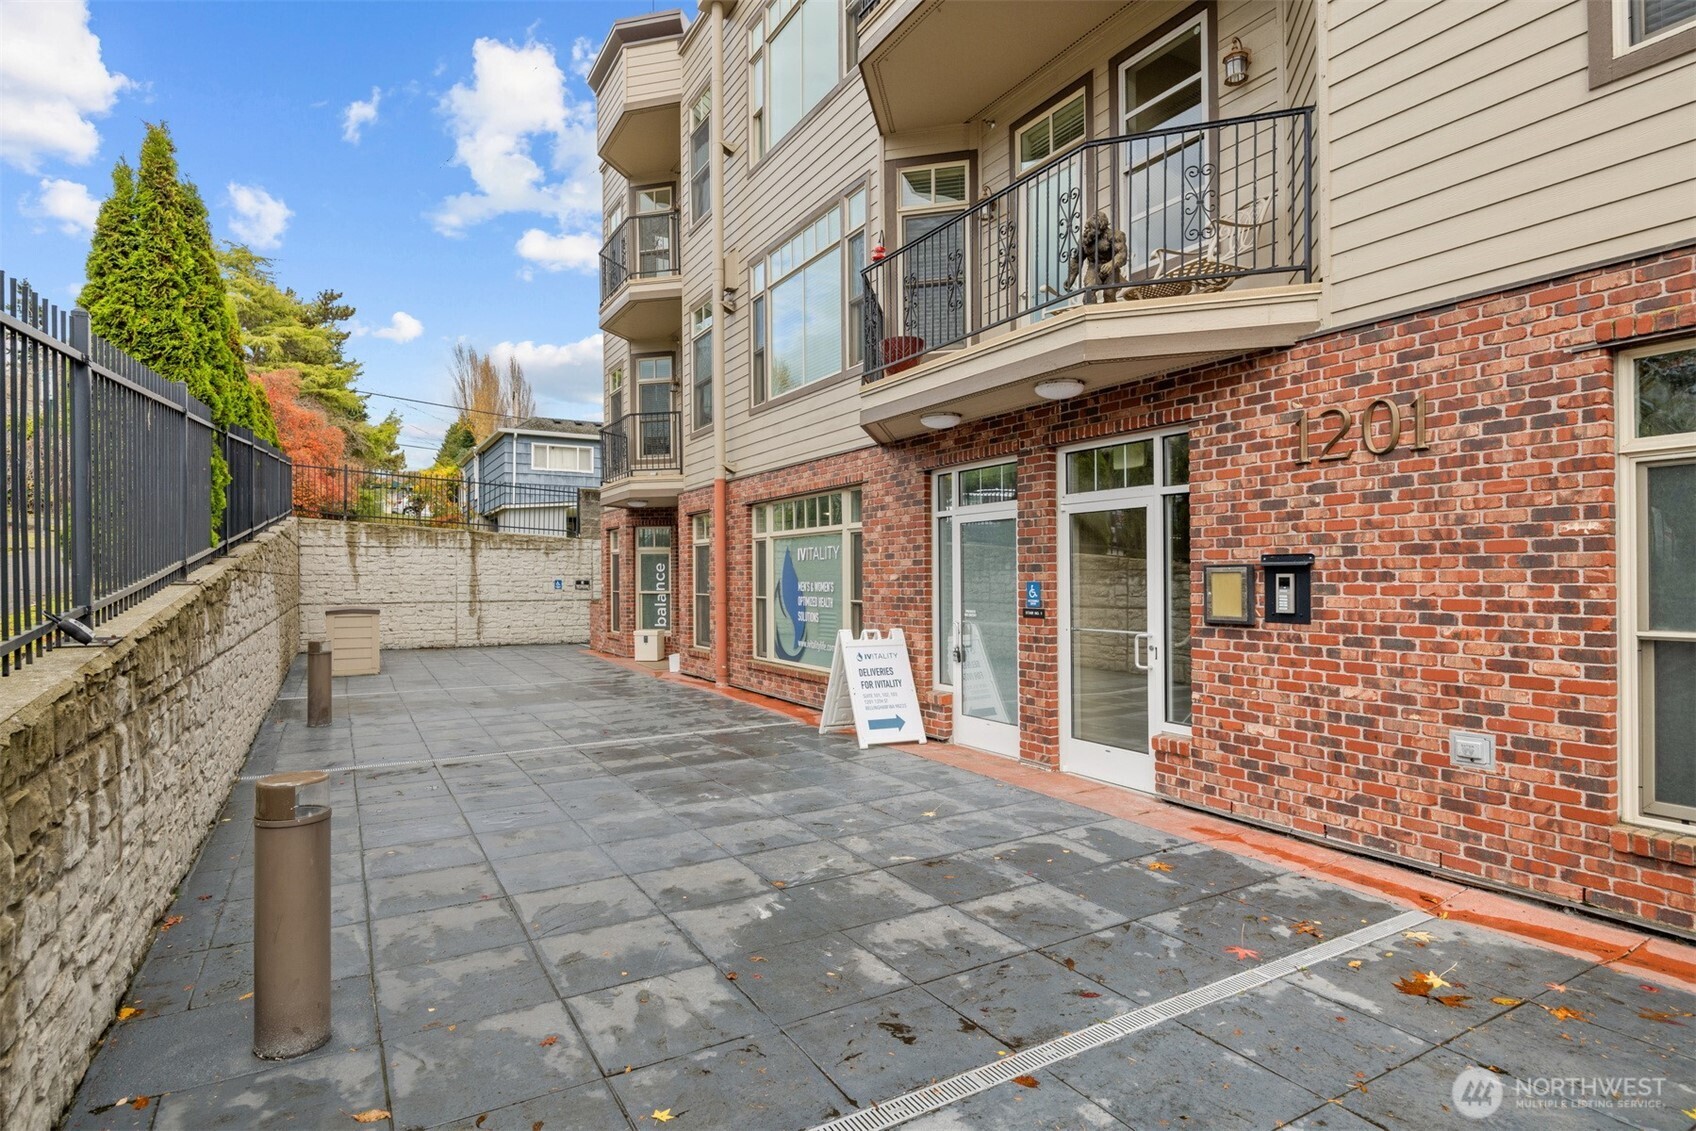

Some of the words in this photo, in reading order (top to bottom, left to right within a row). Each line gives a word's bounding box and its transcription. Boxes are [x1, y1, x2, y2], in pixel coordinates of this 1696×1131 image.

[1295, 393, 1430, 465] 1201
[797, 545, 840, 561] IVITALITY
[814, 581, 834, 593] WOMEN'S
[654, 562, 667, 627] balance
[797, 596, 818, 607] OPTIMIZED
[818, 597, 833, 608] HEALTH
[797, 611, 819, 623] SOLUTIONS
[864, 652, 898, 660] IVITALITY
[858, 667, 894, 677] DELIVERIES
[861, 680, 874, 690] FOR
[874, 679, 902, 689] IVITALITY
